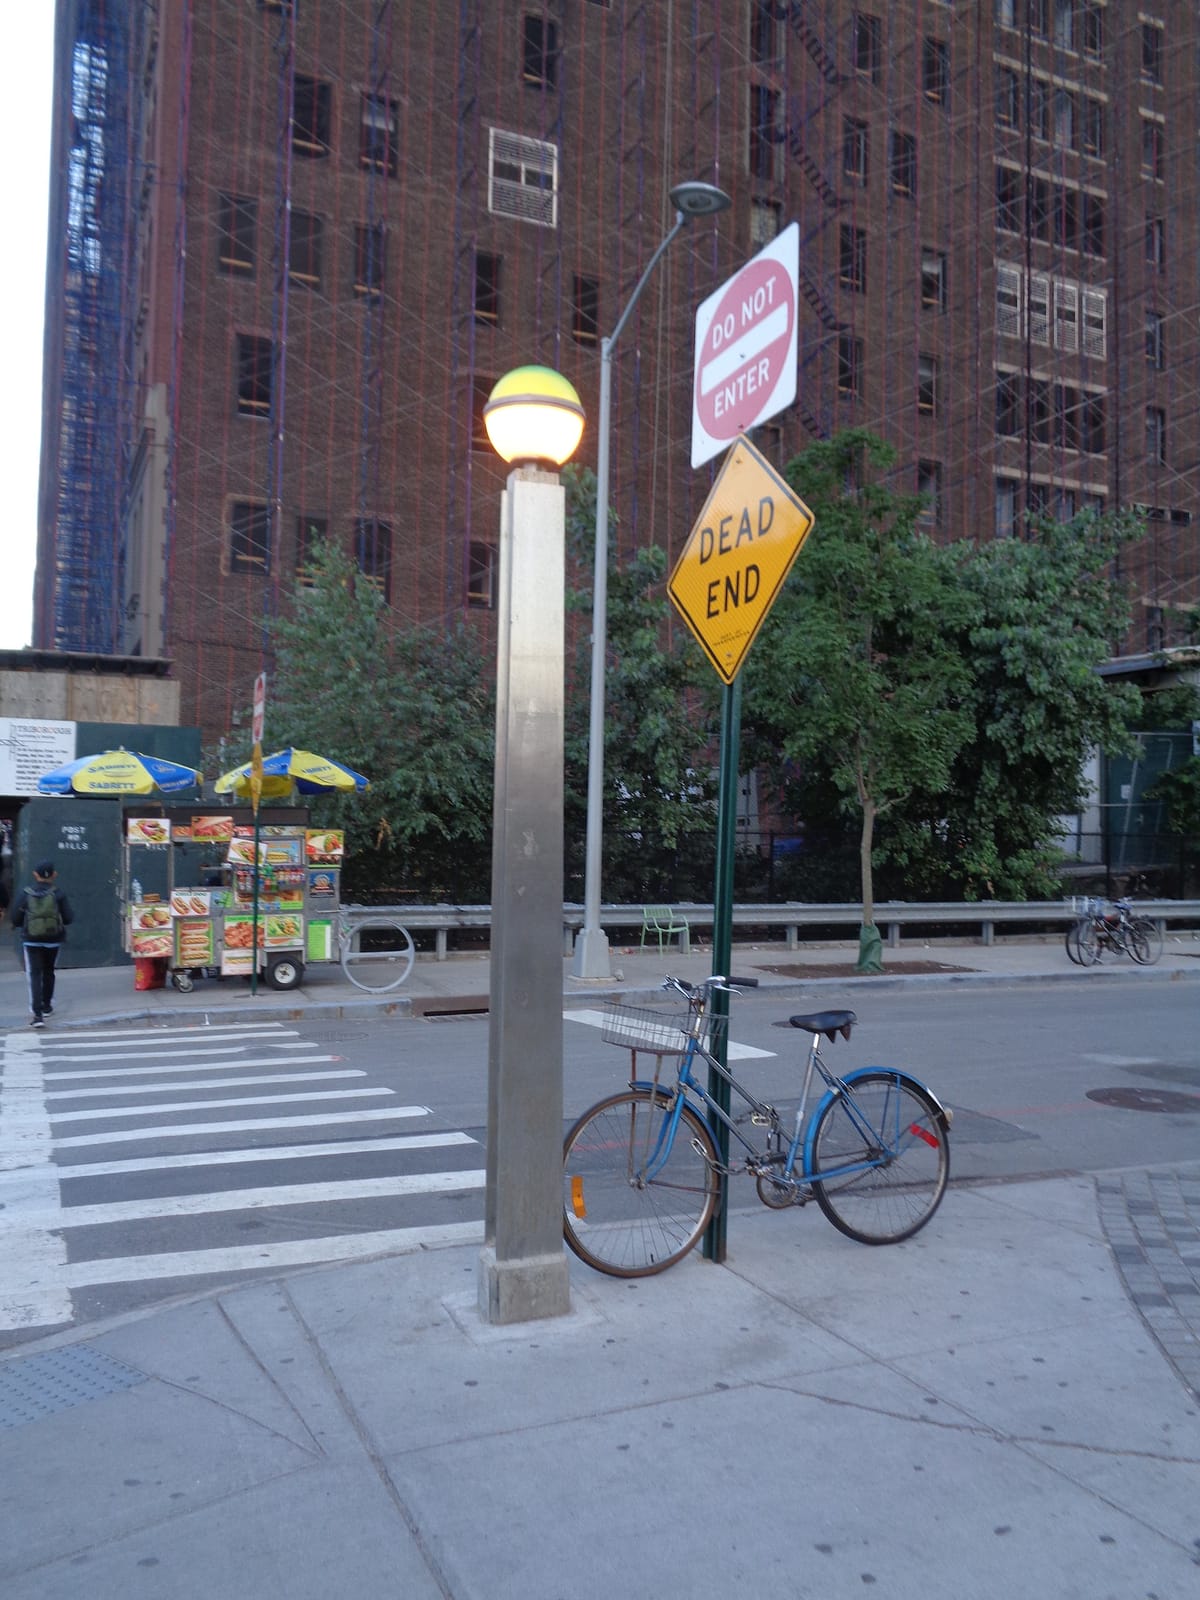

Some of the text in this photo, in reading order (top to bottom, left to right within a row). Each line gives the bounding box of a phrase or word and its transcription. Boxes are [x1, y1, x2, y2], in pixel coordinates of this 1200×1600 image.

[712, 276, 776, 350] DO NOT
[713, 357, 770, 419] ENTER
[699, 496, 774, 565] DEAD
[706, 563, 760, 619] END
[88, 781, 136, 790] SABRETT
[58, 842, 89, 850] BILLS
[61, 826, 86, 834] POST
